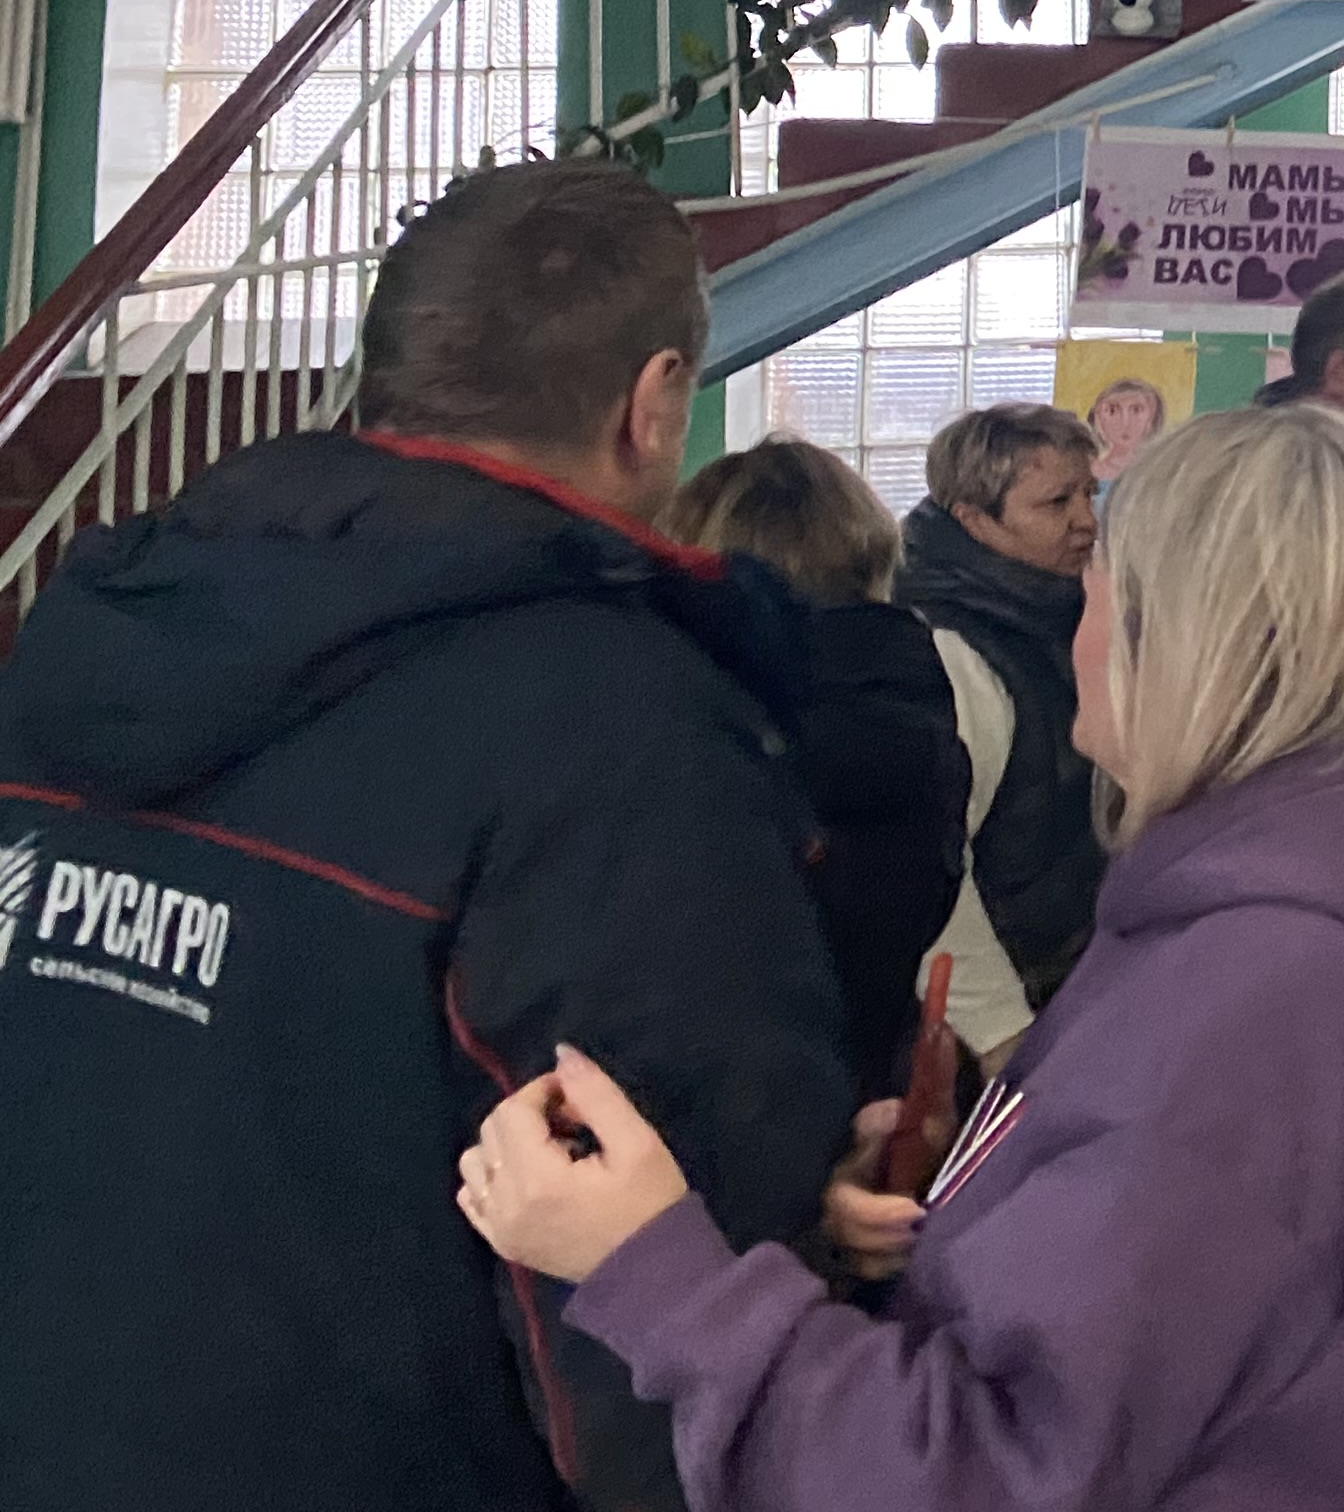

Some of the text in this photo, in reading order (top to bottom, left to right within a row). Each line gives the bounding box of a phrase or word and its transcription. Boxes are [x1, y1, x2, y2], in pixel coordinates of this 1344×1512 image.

[1157, 223, 1318, 254] ЛЮБИМ
[1153, 256, 1234, 285] ВАС
[37, 861, 231, 987] РУСАГРО
